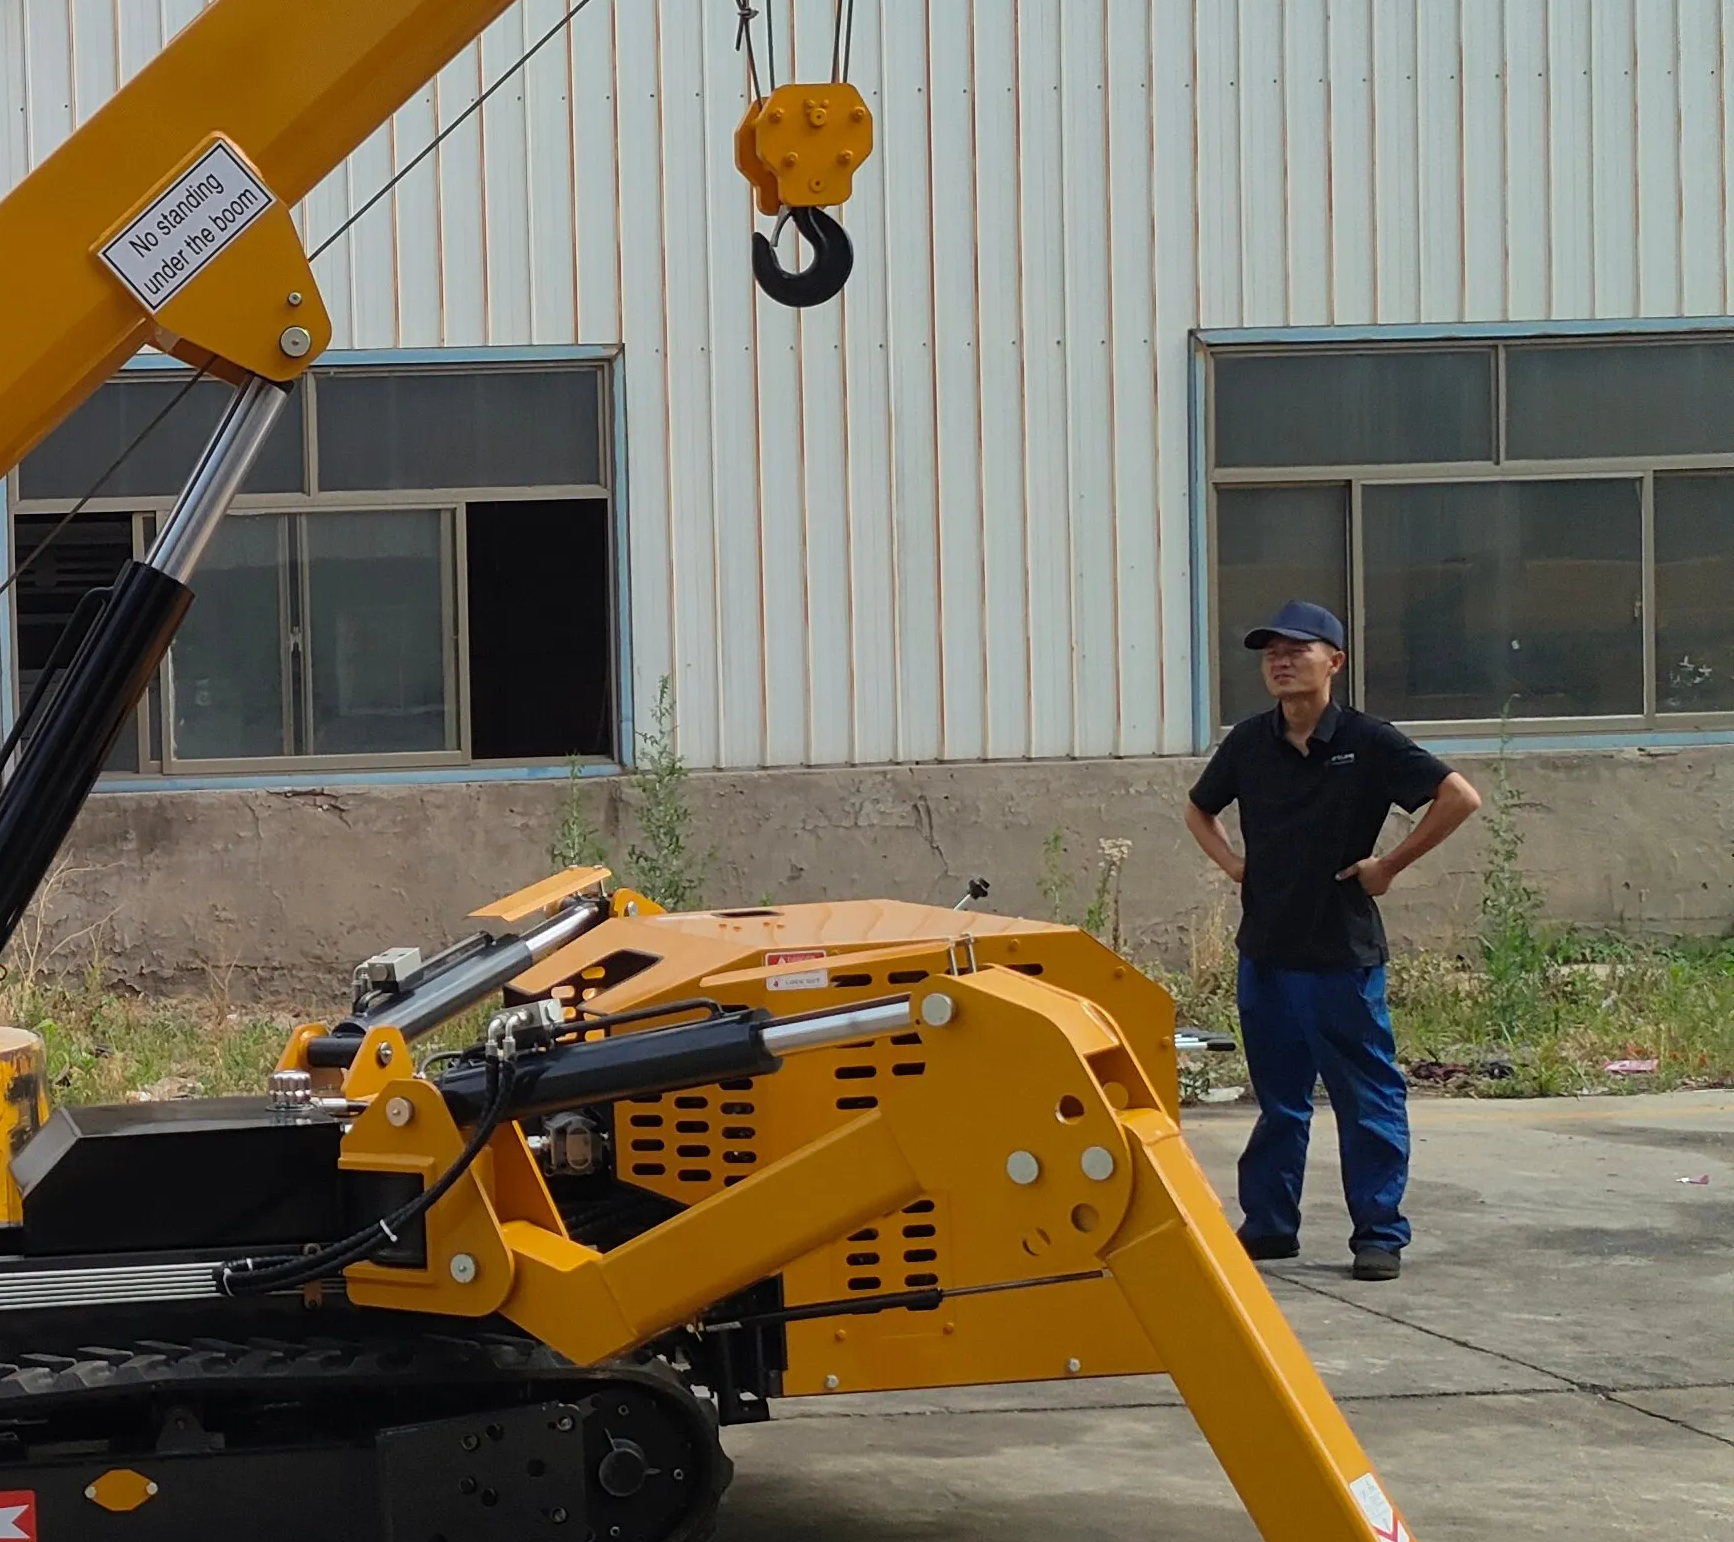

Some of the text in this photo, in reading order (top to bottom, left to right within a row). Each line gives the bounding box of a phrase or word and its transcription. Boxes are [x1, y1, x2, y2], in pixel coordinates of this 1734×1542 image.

[128, 172, 225, 258] No standing
[143, 188, 259, 295] under the boom
